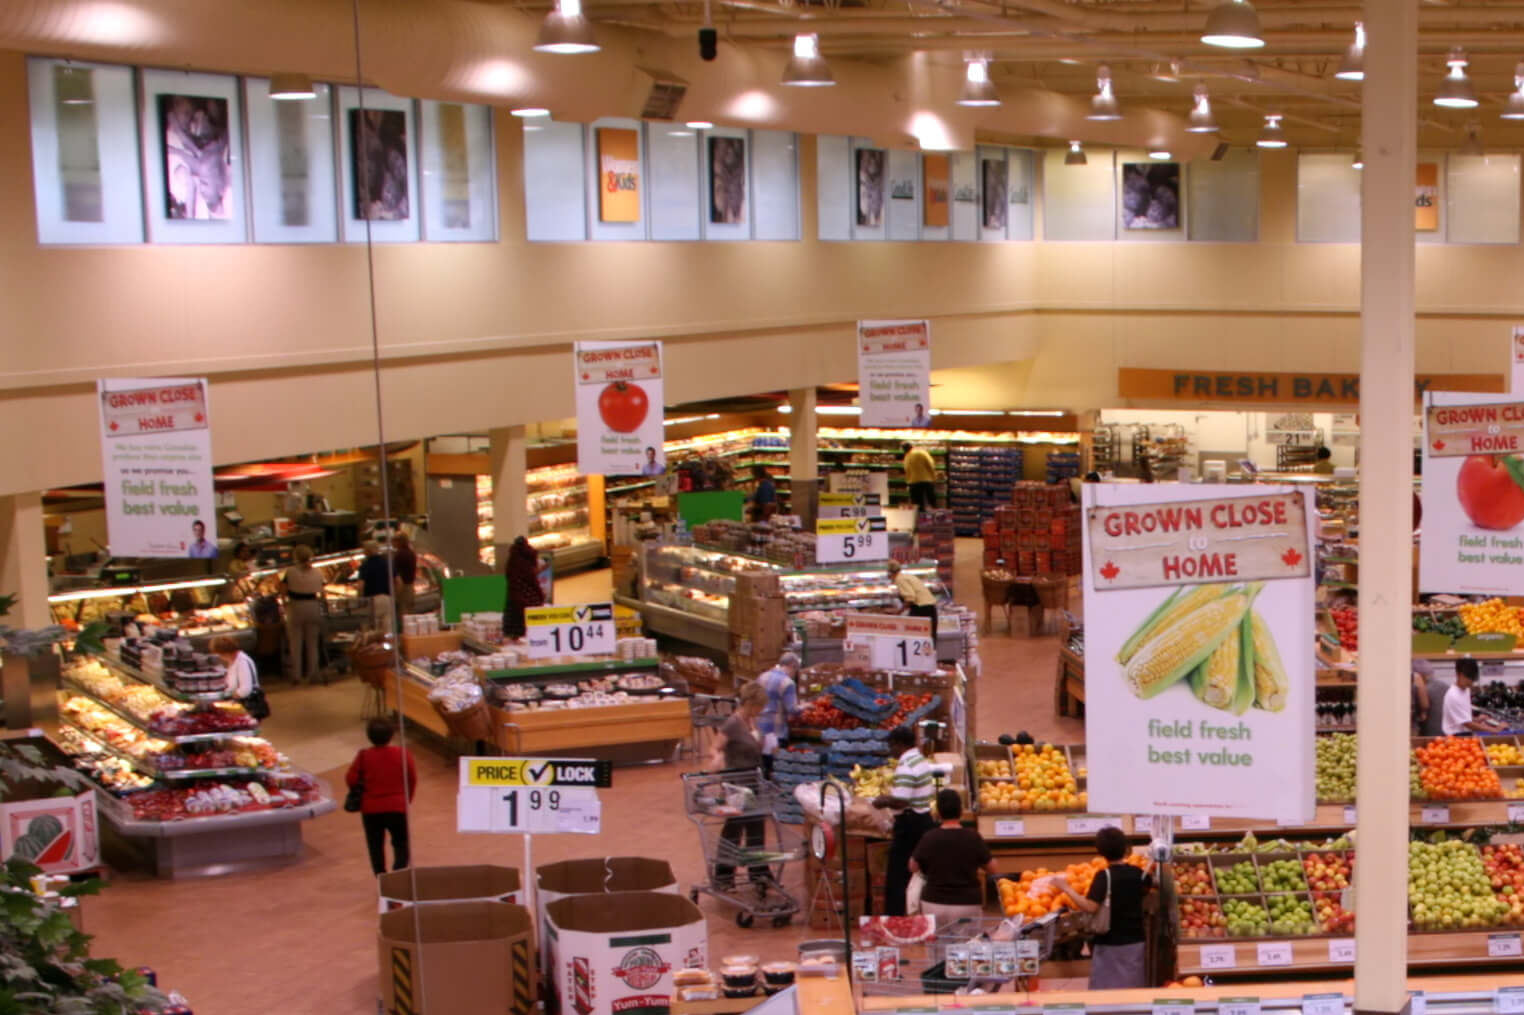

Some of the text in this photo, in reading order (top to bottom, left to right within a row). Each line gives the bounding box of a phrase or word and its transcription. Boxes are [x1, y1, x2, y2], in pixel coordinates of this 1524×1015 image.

[1173, 375, 1431, 399] FRESH BAKY
[110, 386, 197, 408] GROWN CLOSE
[137, 415, 176, 430] HOME
[1436, 407, 1497, 425] GROWN
[1470, 435, 1518, 452] HOME
[122, 480, 199, 497] field fresh
[122, 499, 200, 516] best value
[1103, 500, 1288, 536] GROWN CLOSE
[1458, 534, 1523, 549] field fresh
[1162, 552, 1238, 580] HOME
[1457, 550, 1524, 565] best value
[1148, 718, 1252, 741] field fresh
[1147, 744, 1253, 767] best value
[476, 765, 596, 782] PRICE LOCK
